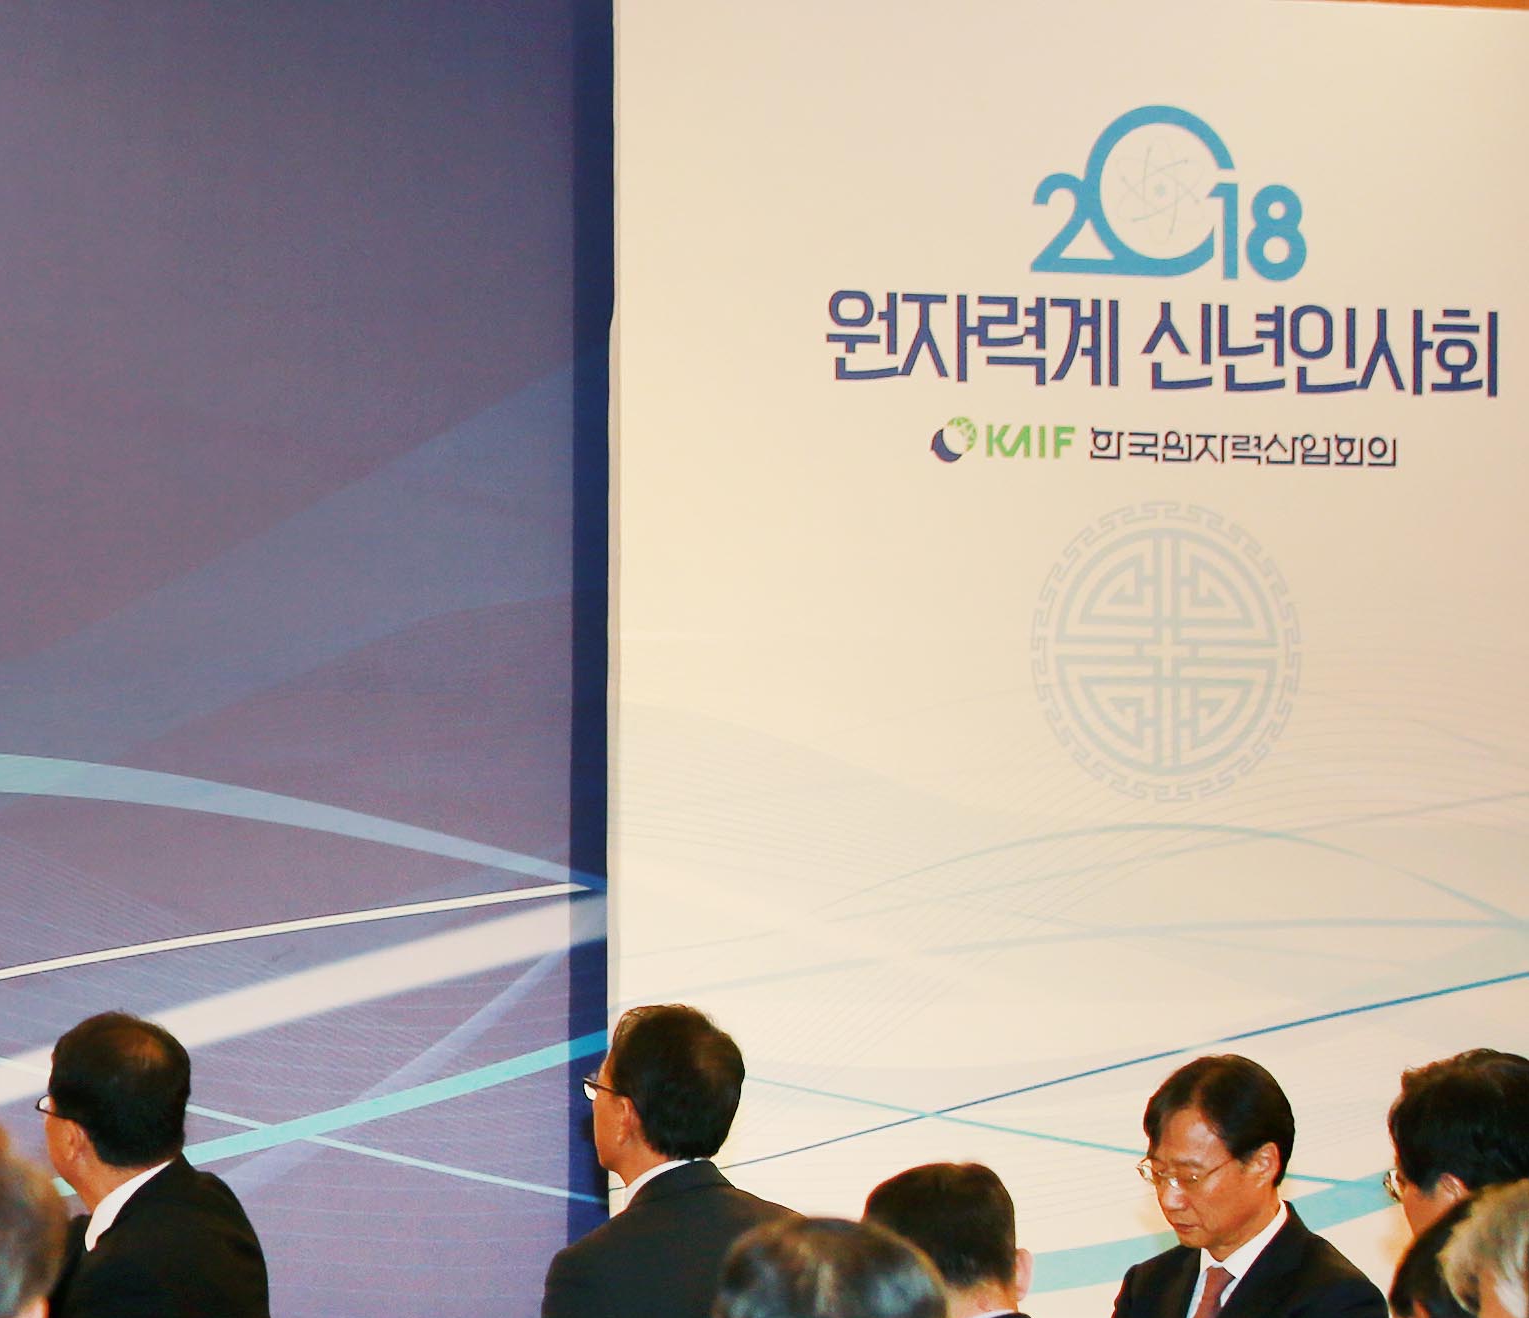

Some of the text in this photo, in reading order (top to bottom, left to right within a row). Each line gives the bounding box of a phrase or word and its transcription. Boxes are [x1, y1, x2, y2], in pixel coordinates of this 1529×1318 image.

[1029, 104, 1308, 282] 2018
[826, 289, 1499, 399] 원자력계 신년인사회
[985, 423, 1398, 468] KAIF 한국원자력산업회의
